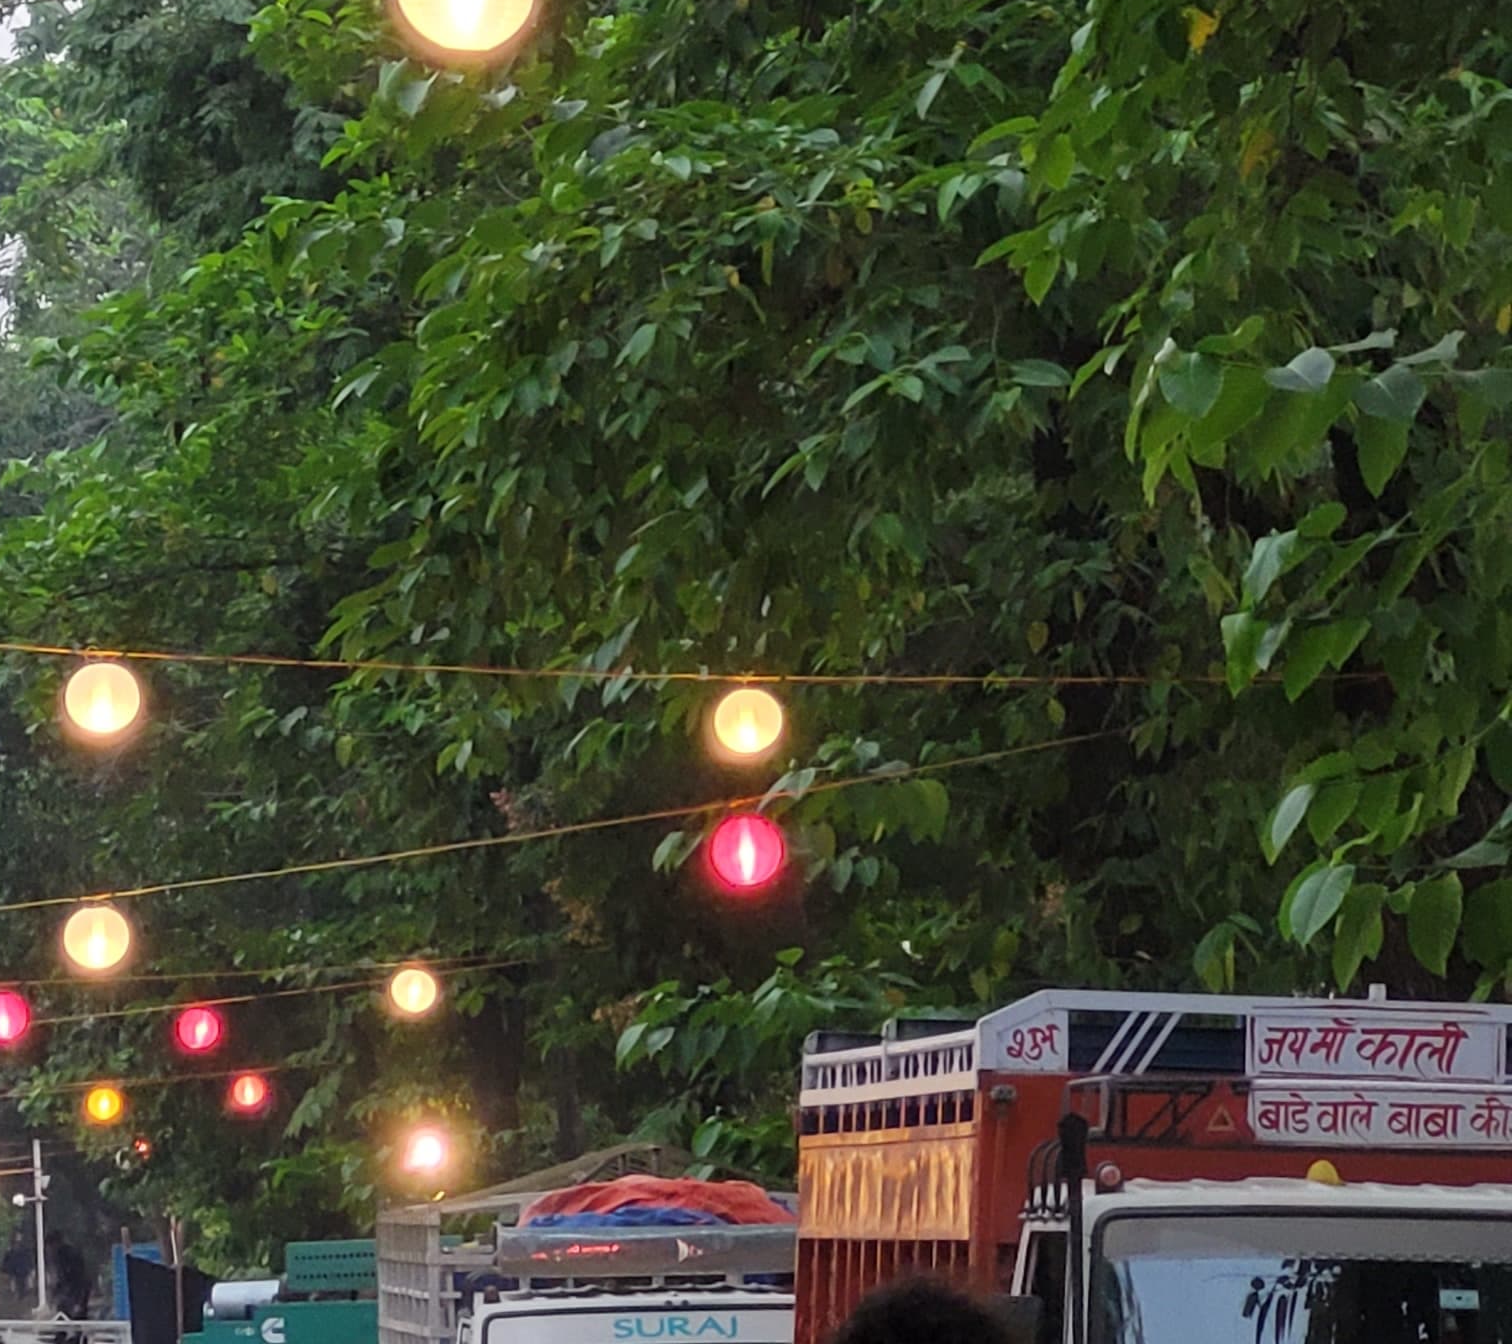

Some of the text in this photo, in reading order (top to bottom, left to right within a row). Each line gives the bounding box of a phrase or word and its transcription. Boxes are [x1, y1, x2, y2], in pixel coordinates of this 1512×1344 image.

[1355, 1020, 1470, 1076] काली
[1387, 1102, 1467, 1140] बाबा
[614, 1315, 738, 1339] SURAJ
